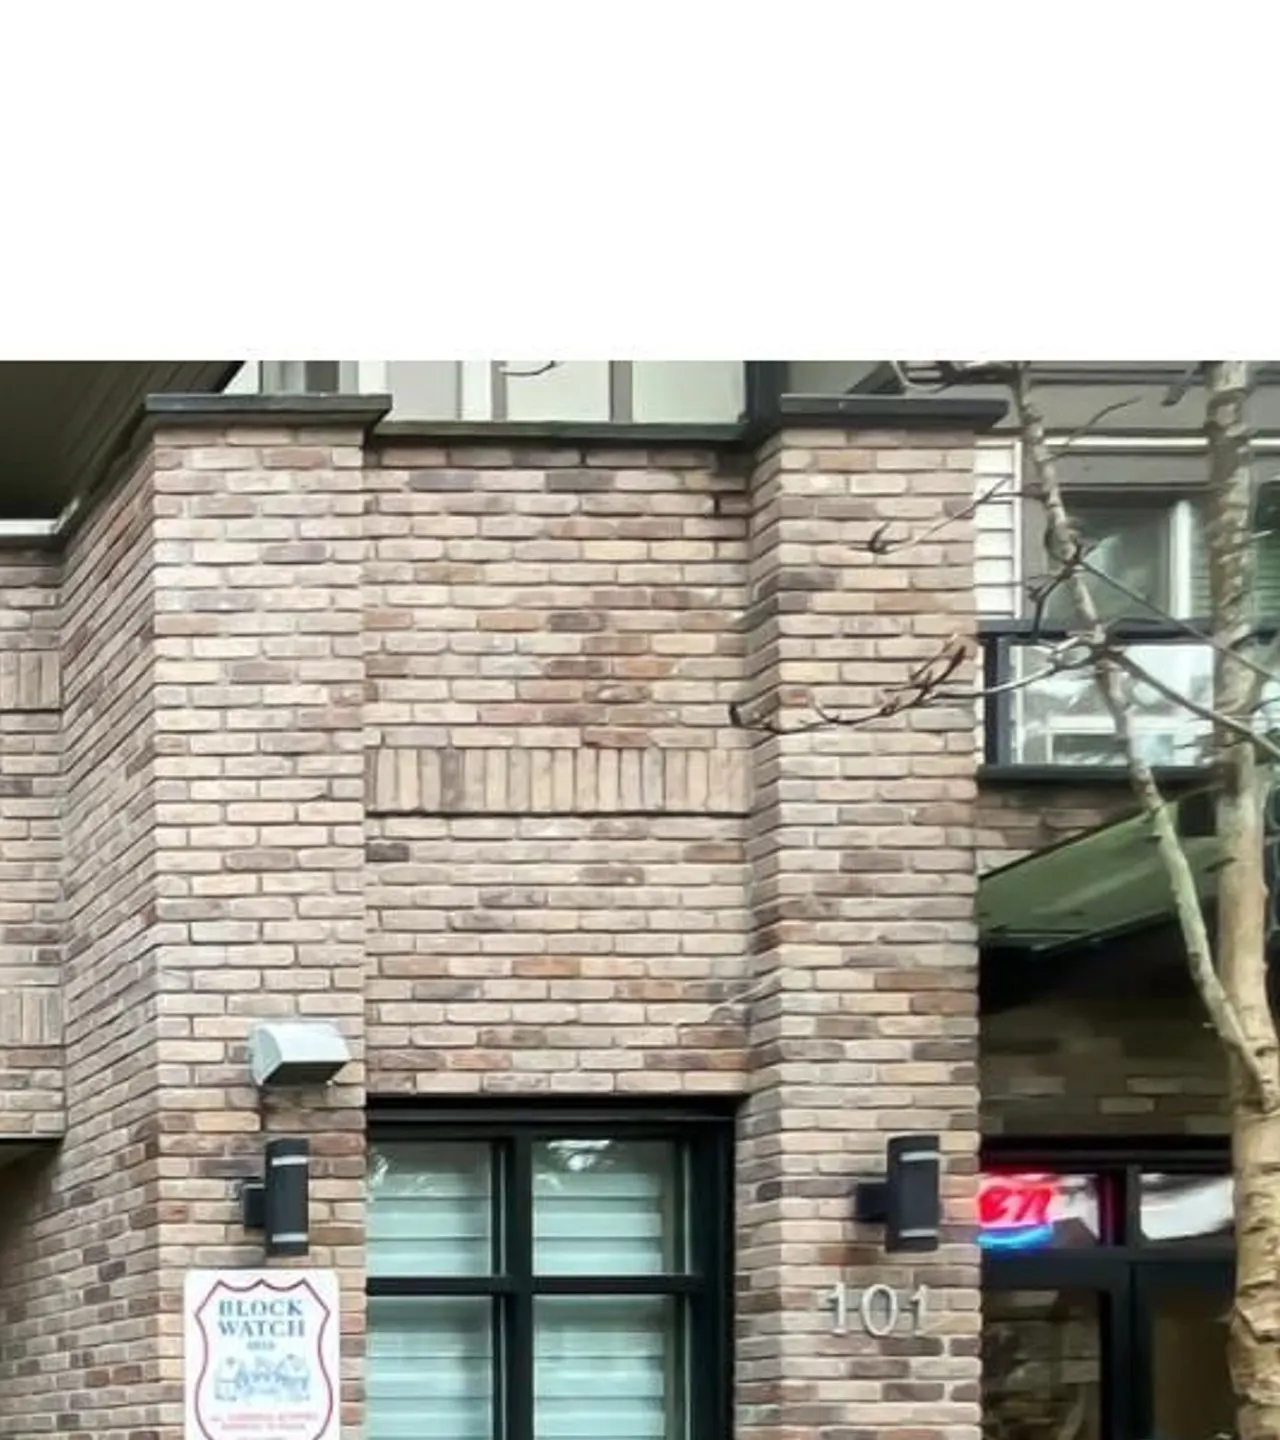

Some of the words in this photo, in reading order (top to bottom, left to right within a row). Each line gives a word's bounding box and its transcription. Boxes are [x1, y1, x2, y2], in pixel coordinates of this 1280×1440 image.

[218, 1299, 303, 1317] BLOCK
[824, 1282, 929, 1337] 101
[217, 1319, 306, 1337] WATCH
